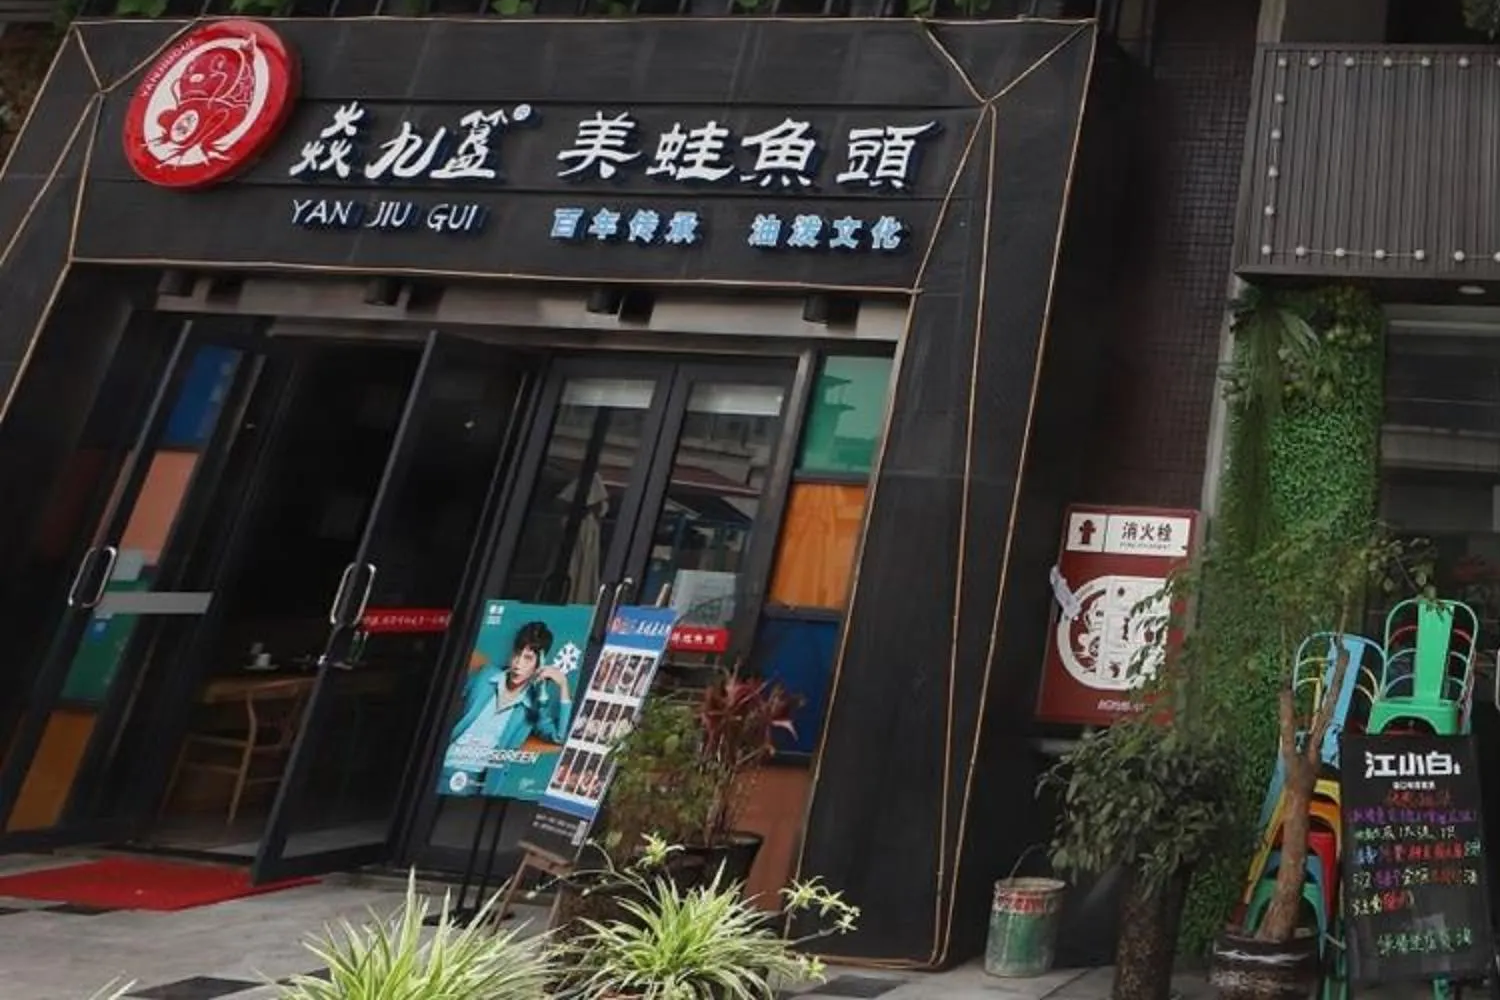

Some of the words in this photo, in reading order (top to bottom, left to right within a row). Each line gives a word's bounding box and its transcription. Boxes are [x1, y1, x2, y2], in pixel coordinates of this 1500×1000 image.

[292, 199, 352, 225] YAN
[364, 201, 412, 228] JIU
[426, 203, 479, 231] GUI
[1121, 521, 1174, 543] 消火栓
[1364, 751, 1462, 779] 江小白
